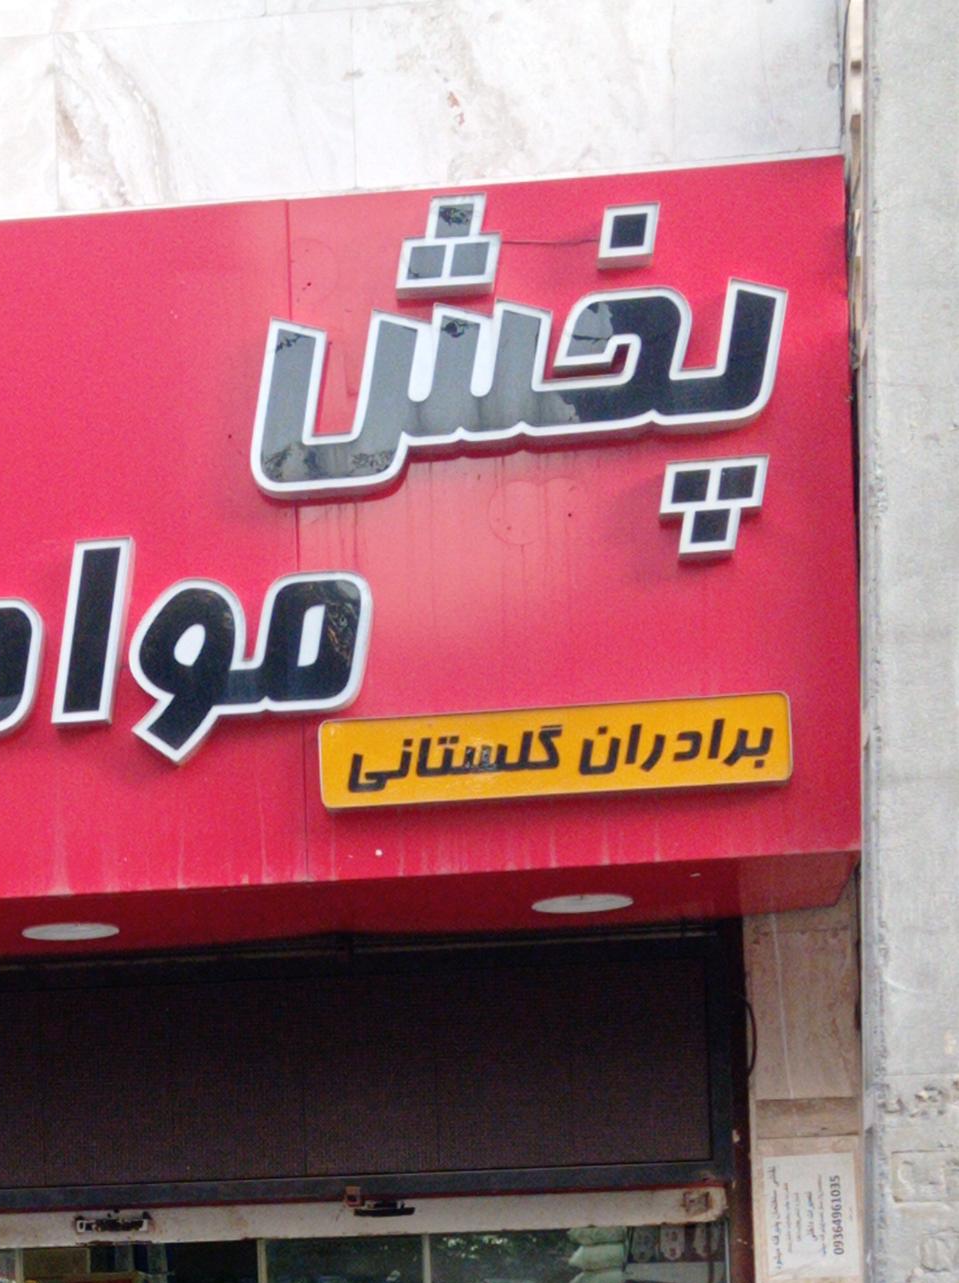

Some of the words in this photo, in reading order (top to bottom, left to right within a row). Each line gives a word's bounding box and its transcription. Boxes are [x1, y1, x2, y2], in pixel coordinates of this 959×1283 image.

[251, 193, 788, 560] پخش
[348, 725, 563, 794] گلستانی
[577, 717, 775, 776] برادران
